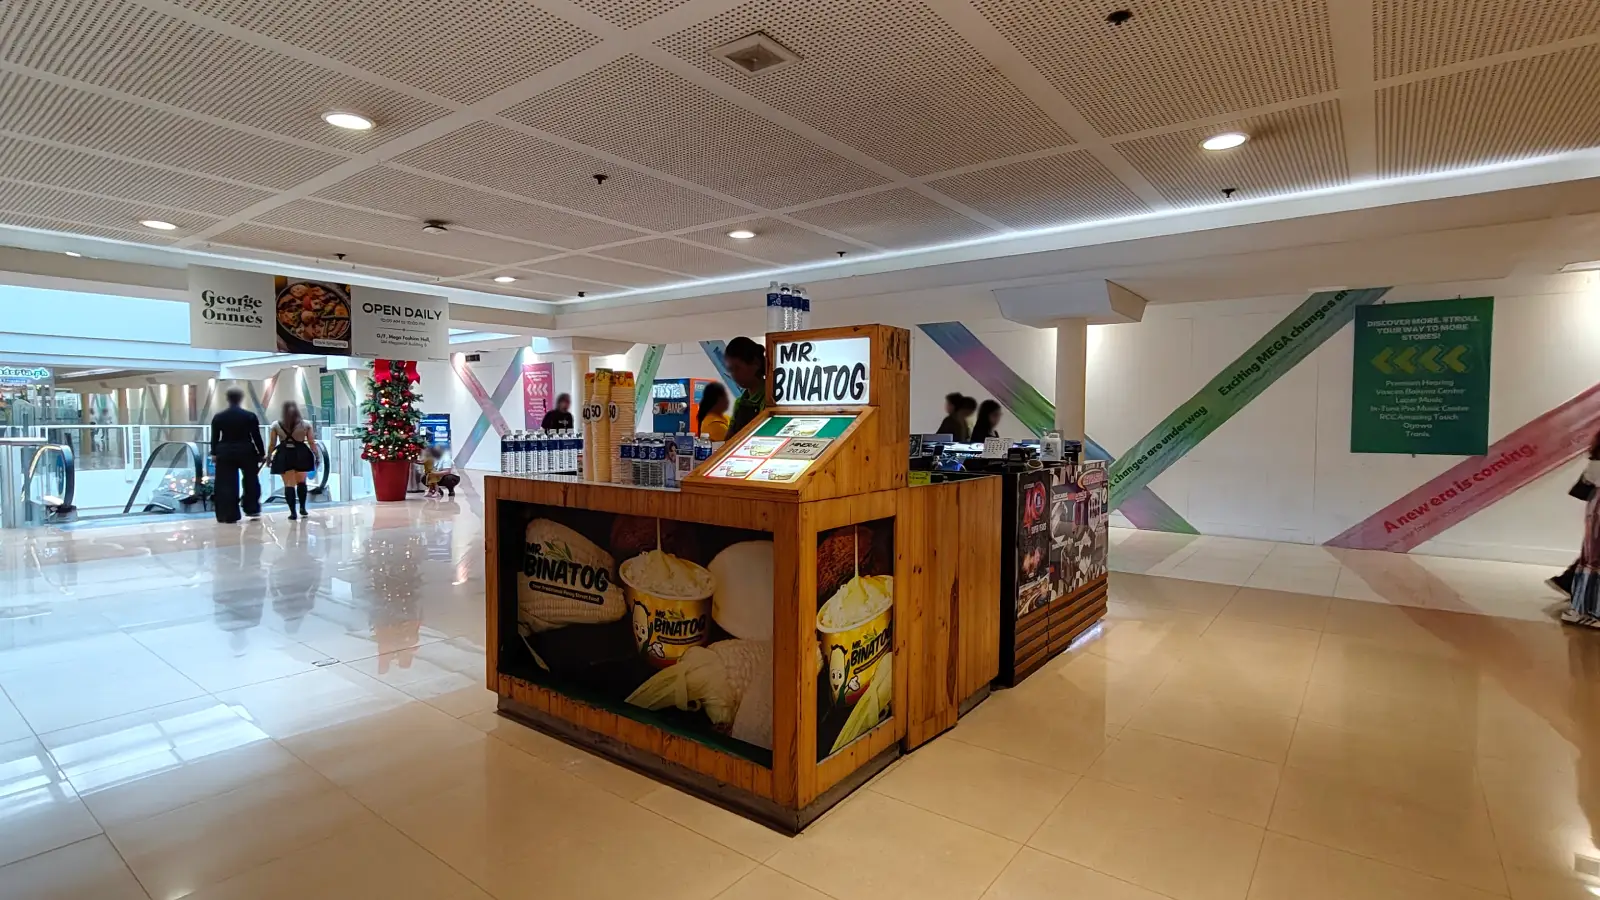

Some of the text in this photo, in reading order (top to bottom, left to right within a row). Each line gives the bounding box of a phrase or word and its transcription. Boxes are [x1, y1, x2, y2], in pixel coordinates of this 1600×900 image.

[202, 290, 262, 310] George
[362, 302, 442, 320] OPEN DAILY
[1366, 319, 1410, 327] DISCOVER
[780, 342, 818, 364] MR.
[1218, 362, 1260, 396] Exciting
[1256, 335, 1293, 365] MEGA
[1290, 299, 1336, 338] changes
[772, 362, 866, 402] BINATOG
[591, 404, 601, 418] 50
[1114, 454, 1148, 488] changes
[1146, 442, 1163, 456] are
[1161, 405, 1208, 446] underway
[1383, 520, 1398, 534] A
[1397, 502, 1430, 526] new
[1430, 488, 1458, 507] era
[1453, 478, 1472, 492] is
[1472, 442, 1539, 482] coming.
[526, 542, 544, 556] MR.
[524, 554, 610, 592] BINATOG
[852, 640, 862, 650] MR.
